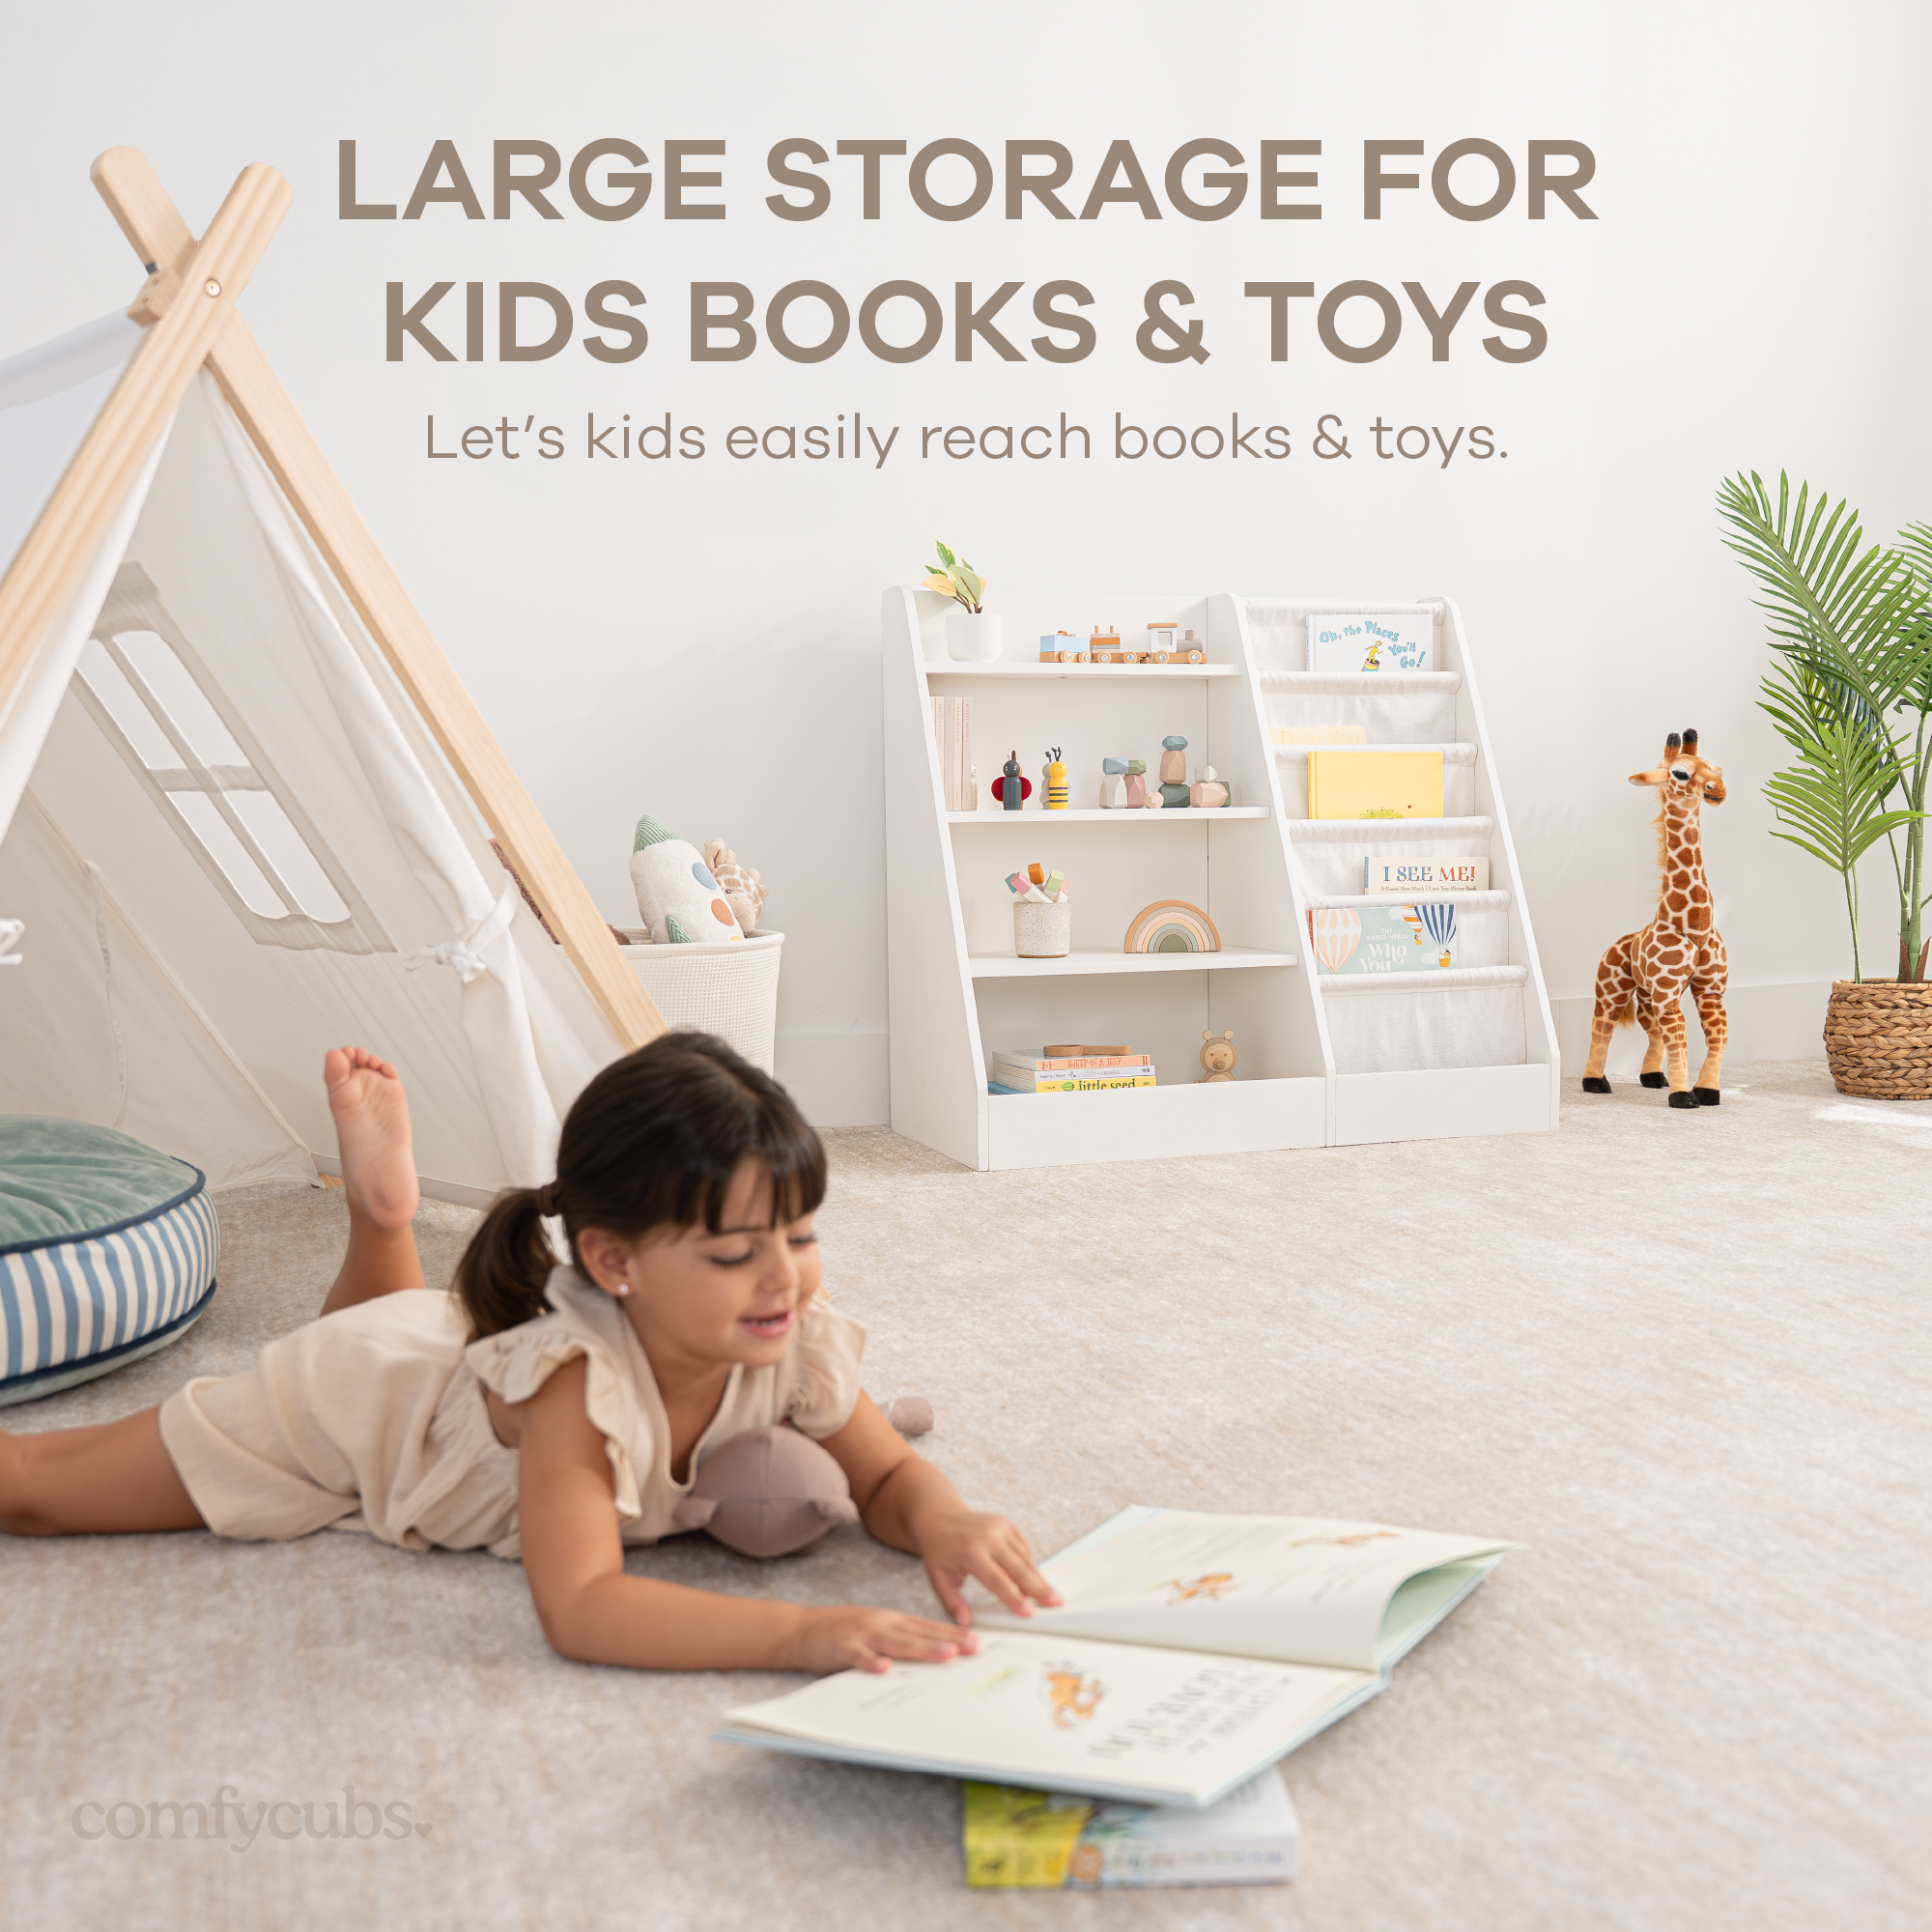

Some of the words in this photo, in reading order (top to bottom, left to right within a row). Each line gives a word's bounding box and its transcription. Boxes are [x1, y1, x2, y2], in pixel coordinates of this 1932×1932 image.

[1319, 630, 1343, 643] Oh,
[1343, 625, 1363, 637] the
[1364, 620, 1400, 642] Places
[1400, 650, 1426, 669] Go!
[1278, 730, 1323, 746] Dear
[1327, 729, 1360, 746] Zoo
[1382, 866, 1391, 882] I
[1396, 866, 1434, 882] SEE
[1438, 866, 1476, 882] ME!
[1368, 942, 1407, 965] Who
[1359, 957, 1391, 973] You
[1066, 1058, 1089, 1068] SHEEP
[1090, 1058, 1097, 1066] IN
[1099, 1058, 1105, 1066] A
[1106, 1057, 1122, 1066] JEEP
[1078, 1079, 1107, 1091] little
[1110, 1078, 1136, 1090] seed
